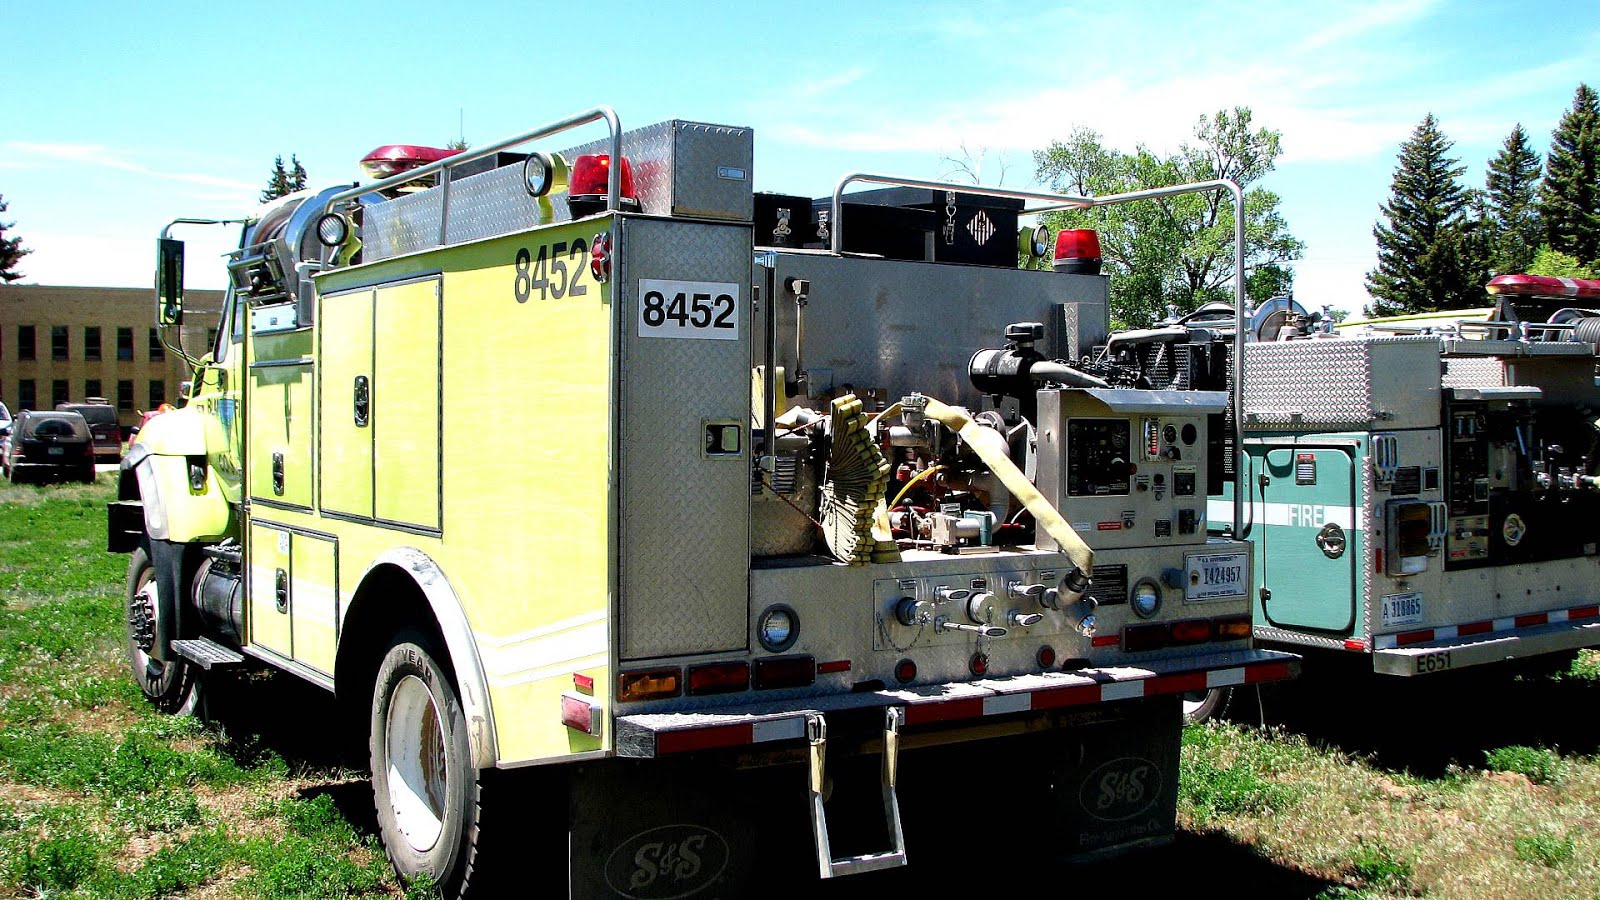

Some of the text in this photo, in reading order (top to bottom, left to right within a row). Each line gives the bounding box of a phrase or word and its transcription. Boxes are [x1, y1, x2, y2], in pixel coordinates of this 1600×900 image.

[514, 237, 588, 304] 8452
[643, 290, 736, 329] 8452
[1288, 503, 1325, 528] FIRE
[1383, 603, 1389, 619] A
[1416, 651, 1451, 673] E651
[628, 834, 708, 891] S&S
